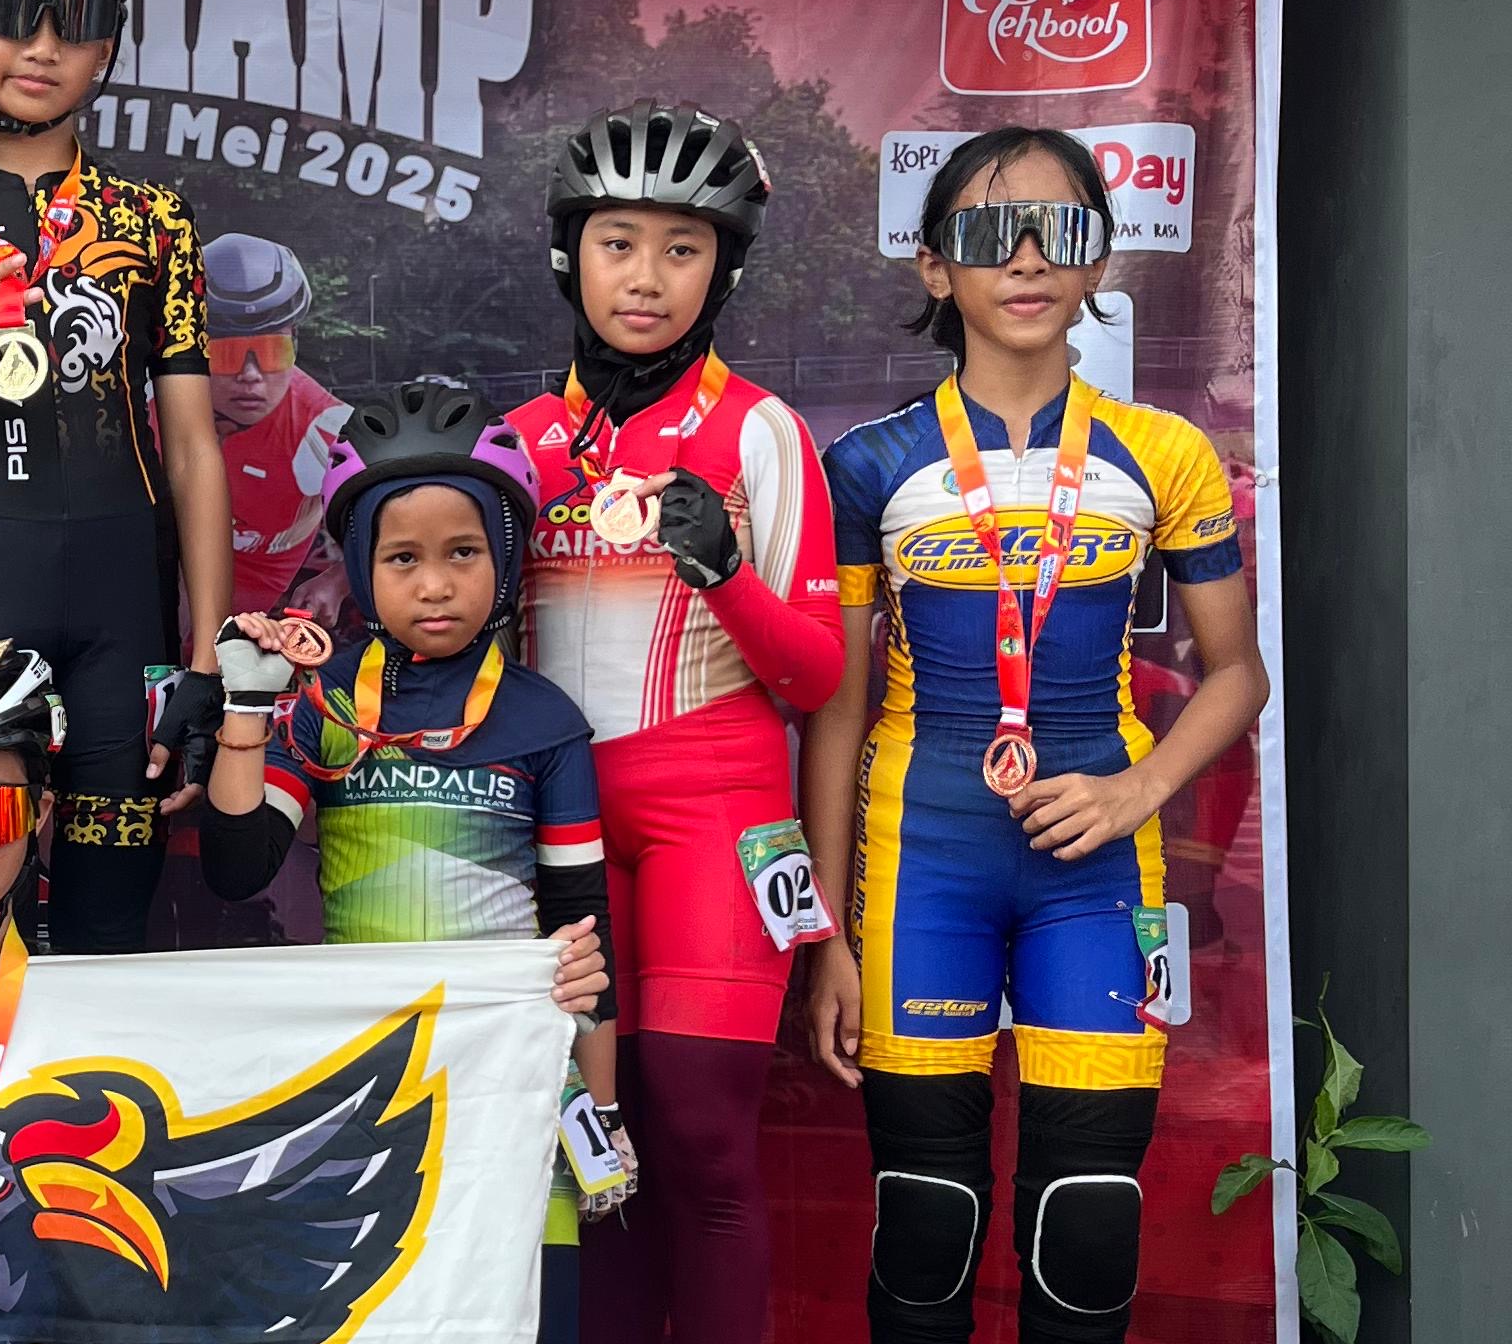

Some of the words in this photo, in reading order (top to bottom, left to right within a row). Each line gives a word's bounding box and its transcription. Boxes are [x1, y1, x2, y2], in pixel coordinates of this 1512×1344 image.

[165, 102, 289, 174] Mei
[298, 130, 481, 223] 2025
[1092, 141, 1186, 205] Day
[1153, 222, 1180, 239] RASA
[4, 417, 30, 481] PIS
[1000, 553, 1086, 567] SKE
[344, 765, 516, 800] MANDALIS
[344, 789, 418, 800] MANDALIKA
[423, 790, 470, 803] INLINE
[473, 797, 515, 810] SKATE
[767, 864, 814, 919] 02
[576, 1107, 610, 1158] 1
